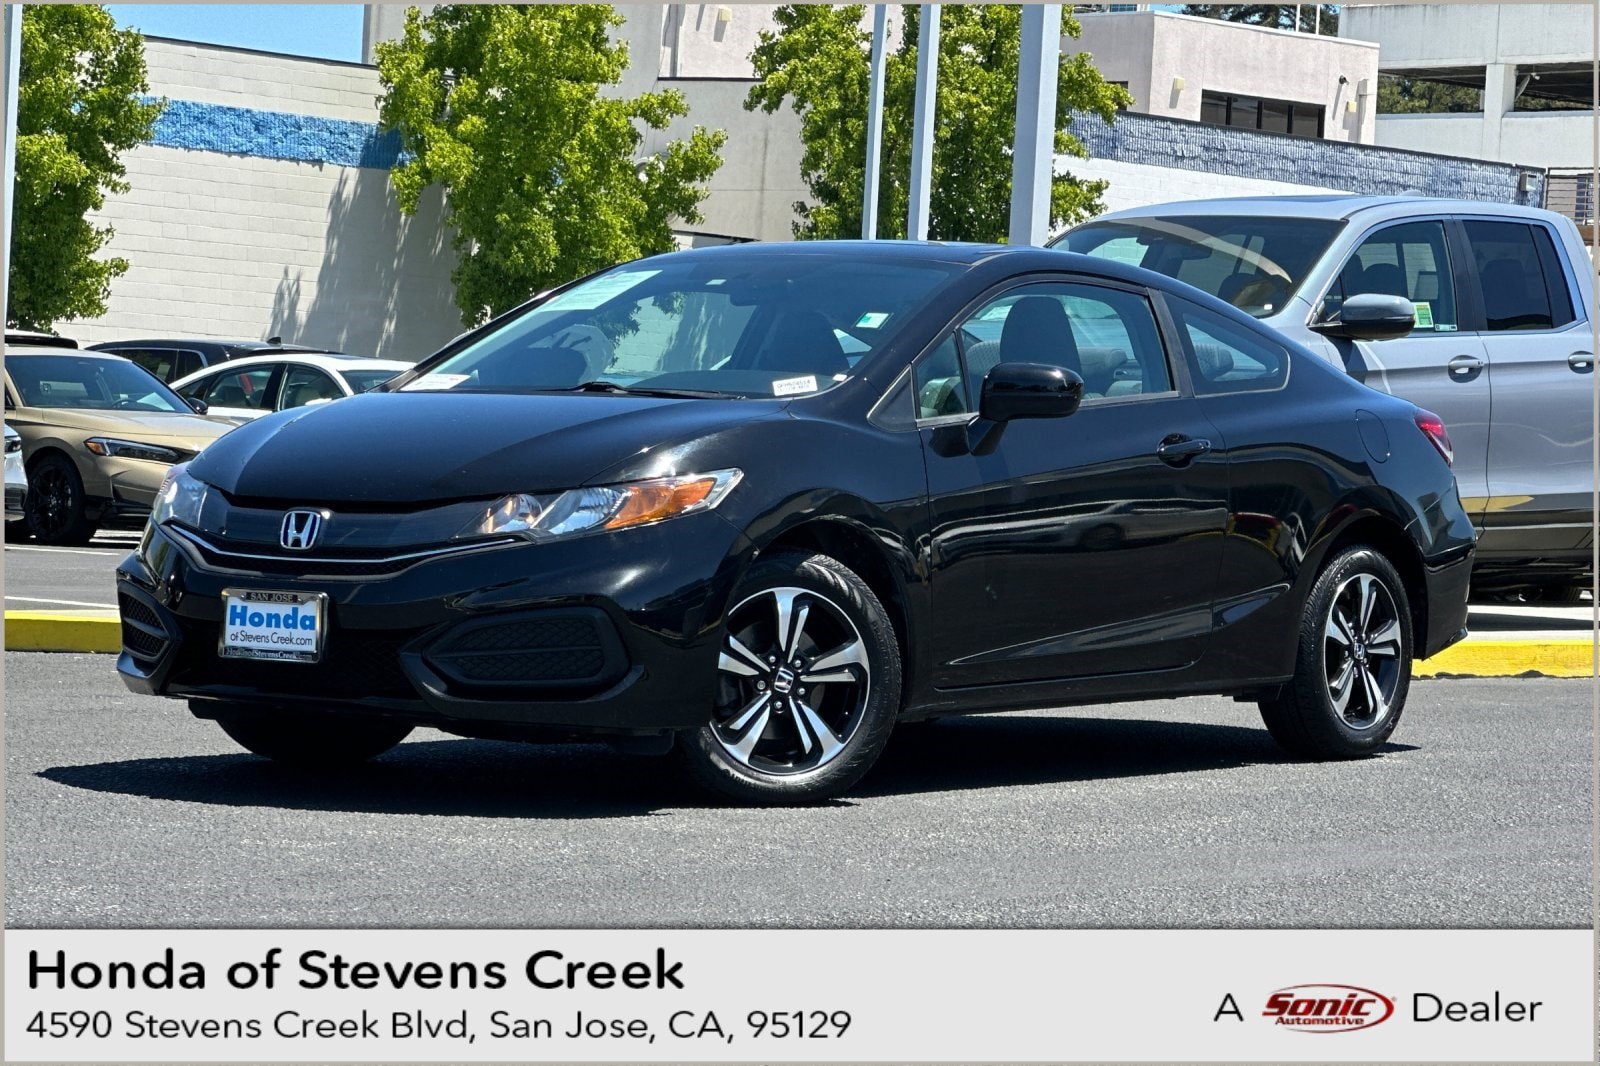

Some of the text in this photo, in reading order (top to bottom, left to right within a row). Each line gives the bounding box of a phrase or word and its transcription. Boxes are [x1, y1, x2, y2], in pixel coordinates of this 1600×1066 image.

[250, 593, 294, 602] SAN JOSE
[229, 604, 316, 631] Honda
[230, 630, 313, 646] of Stevens Creek.com
